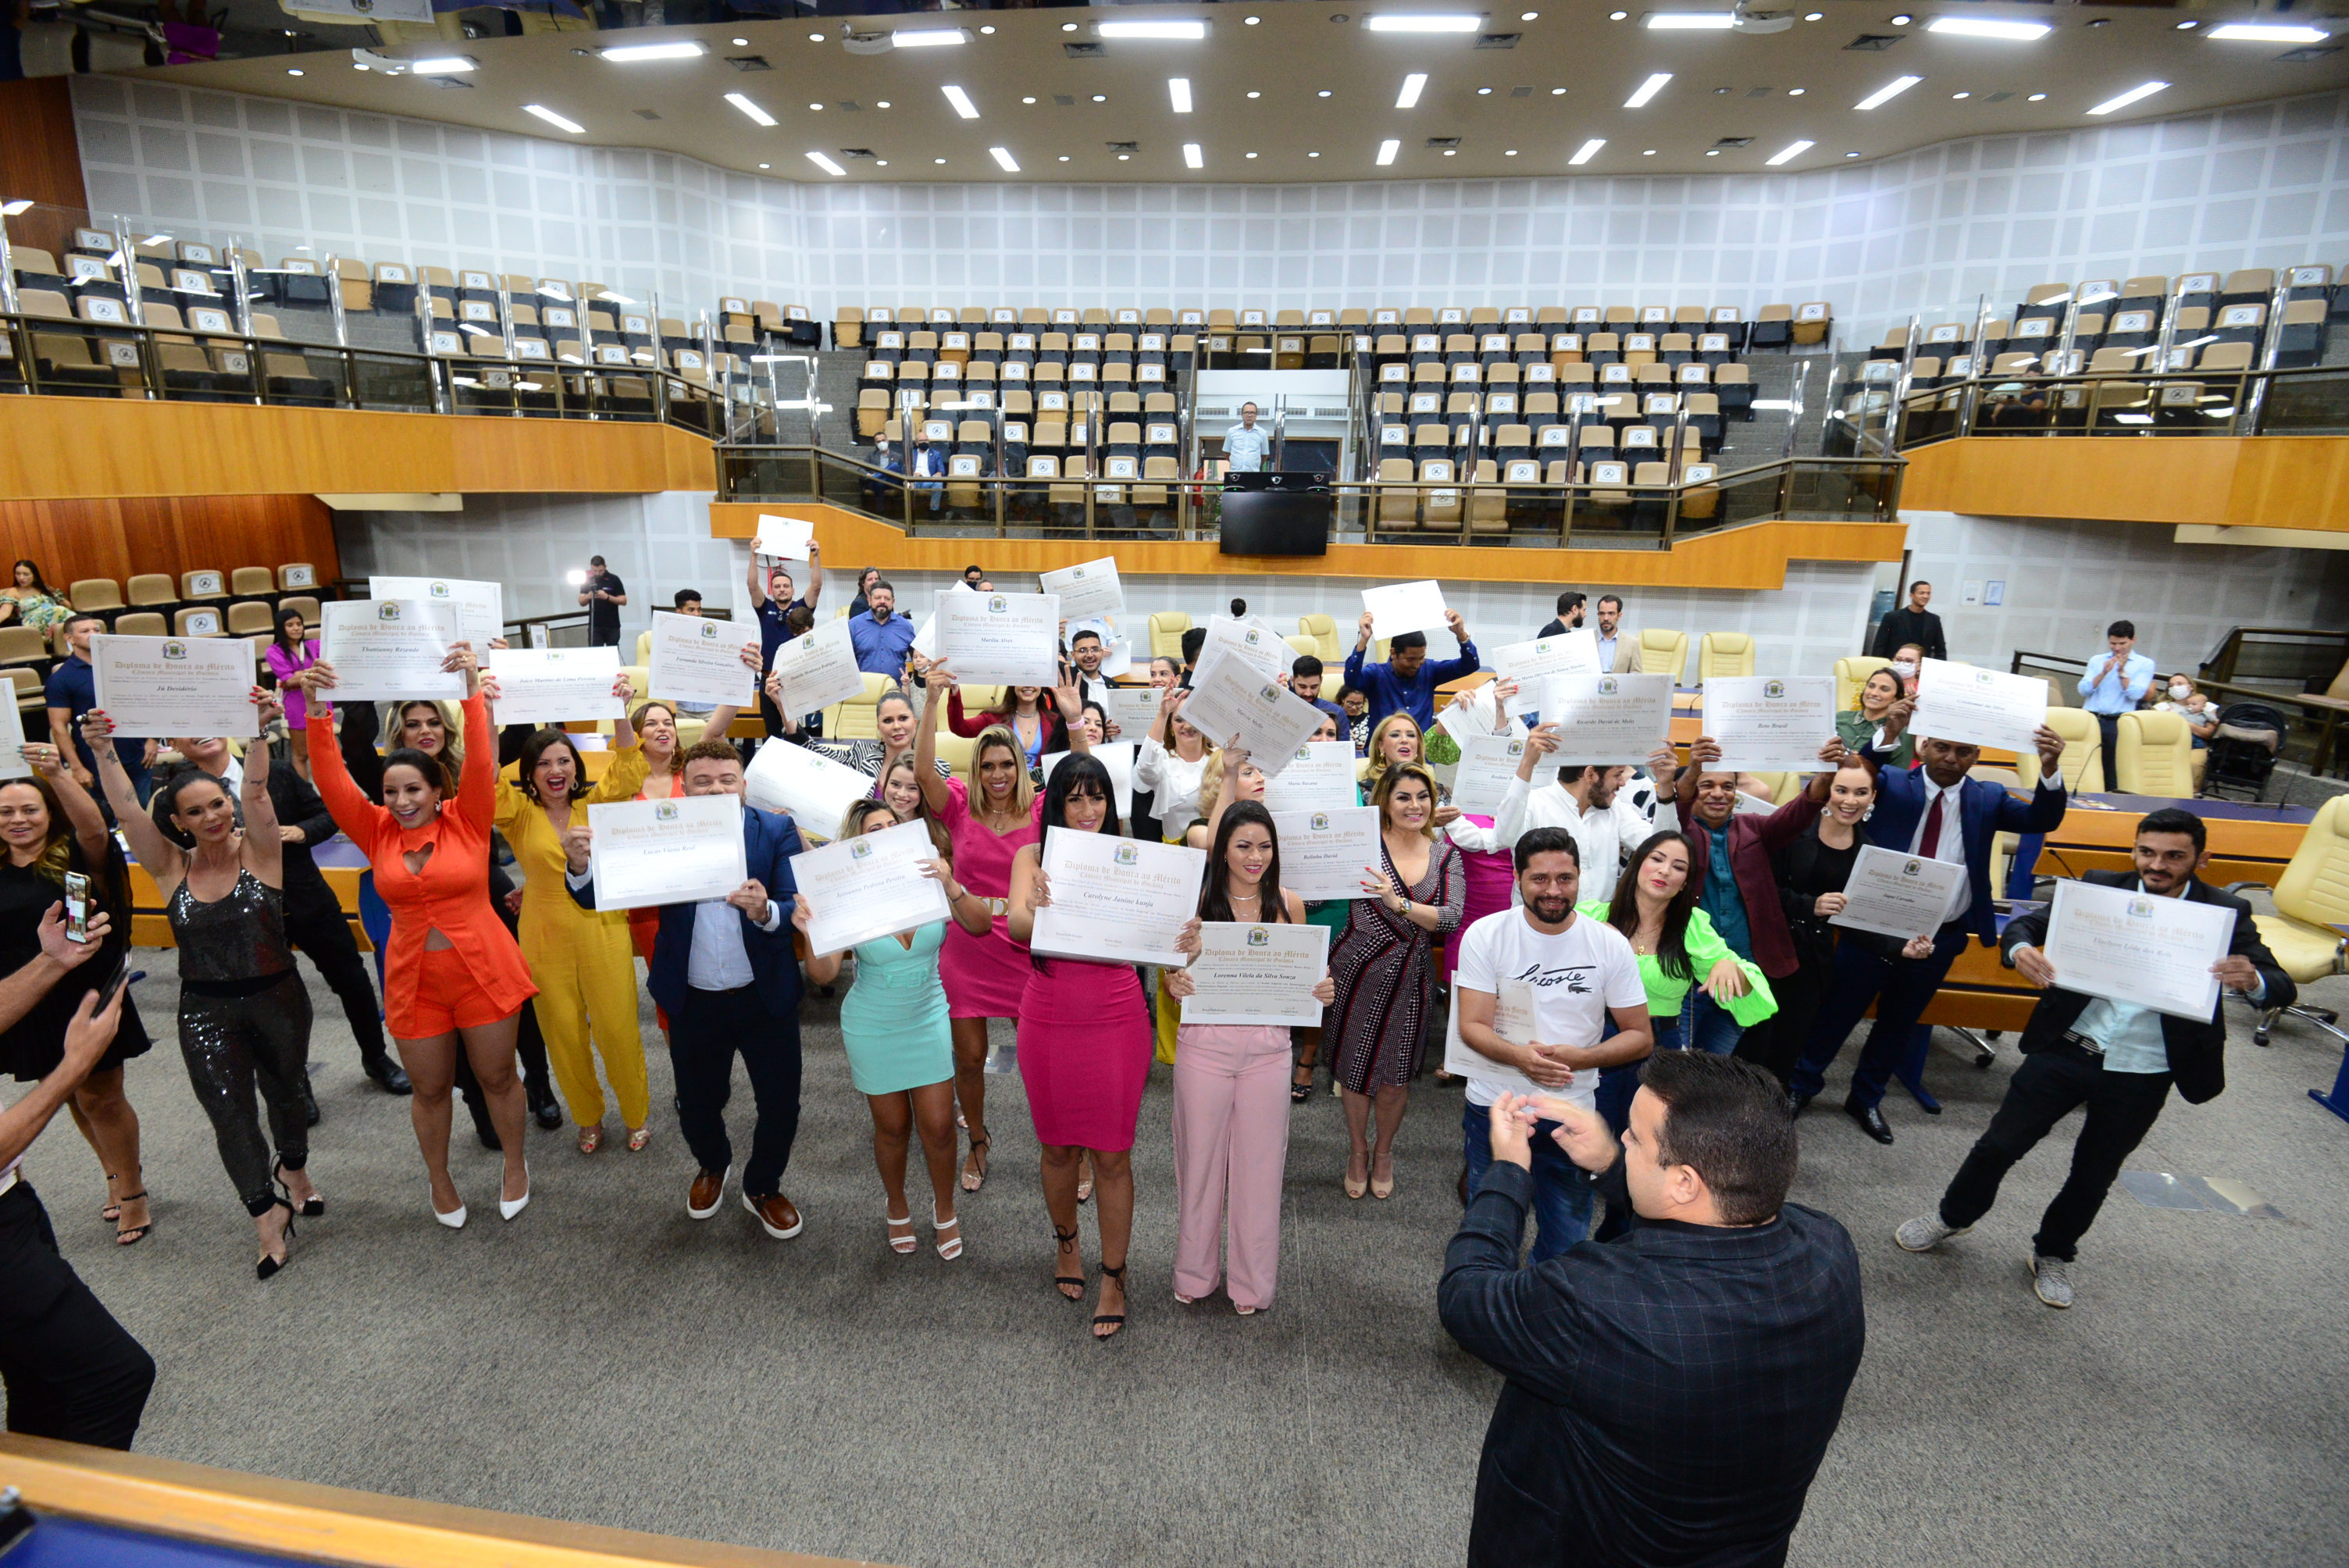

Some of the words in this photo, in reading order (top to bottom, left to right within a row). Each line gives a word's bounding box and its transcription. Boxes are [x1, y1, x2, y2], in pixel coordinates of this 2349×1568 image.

[1064, 861, 1099, 873] Diploma
[1102, 865, 1110, 874] de
[1114, 867, 1139, 878] Honra
[1153, 874, 1181, 885] Mérito
[1080, 871, 1102, 881] Câmara
[1103, 875, 1132, 884] Municipal
[1142, 880, 1163, 889] Goiânia
[1083, 892, 1112, 901] Carolyne
[1113, 896, 1135, 904] Janine
[1135, 899, 1153, 907] kunja
[1284, 950, 1309, 959] Mérito
